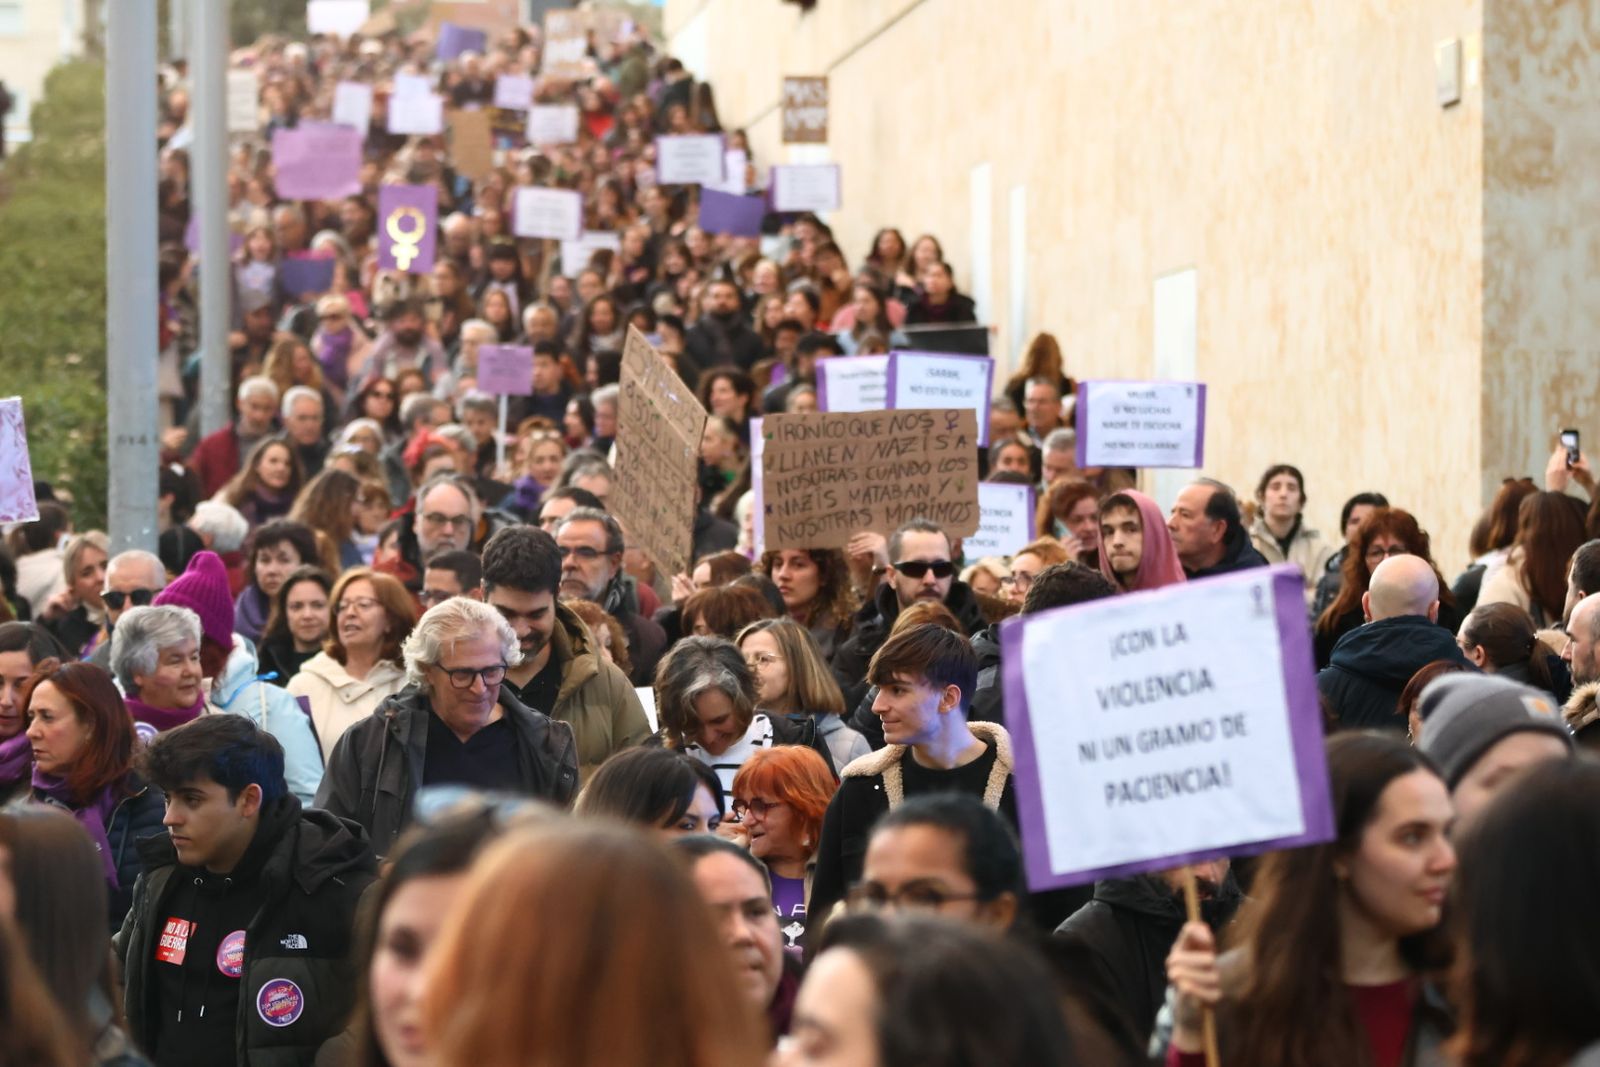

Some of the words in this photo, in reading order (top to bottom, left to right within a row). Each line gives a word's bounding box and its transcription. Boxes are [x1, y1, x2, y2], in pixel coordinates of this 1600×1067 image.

[910, 385, 923, 394] NO
[848, 418, 882, 439] QUE
[889, 413, 935, 431] NOS
[1102, 421, 1128, 430] NADIE
[1131, 421, 1141, 430] TE
[1143, 421, 1182, 431] ESCUCHA
[1123, 405, 1137, 415] NO
[1139, 405, 1171, 415] LUCHAS
[779, 444, 858, 473] LLAMEN
[955, 435, 968, 449] A
[777, 467, 858, 497] NOSOTRAS
[865, 459, 932, 481] CUANDO
[937, 457, 969, 473] LOS
[849, 482, 931, 505] MATABAN
[938, 477, 952, 496] Y
[777, 508, 873, 543] NOSOTRAS
[886, 497, 974, 524] MORIMOS
[1109, 628, 1155, 659] ¡CON
[1161, 623, 1189, 647] LA
[1096, 667, 1214, 710] VIOLENCIA
[1077, 740, 1097, 763] NI
[1102, 735, 1133, 760] UN
[1136, 718, 1216, 754] GRAMO
[1220, 711, 1248, 739] DE
[1103, 761, 1233, 808] PACIENCIA!
[159, 935, 187, 951] GUERRA
[164, 921, 176, 934] NO
[173, 924, 180, 936] A
